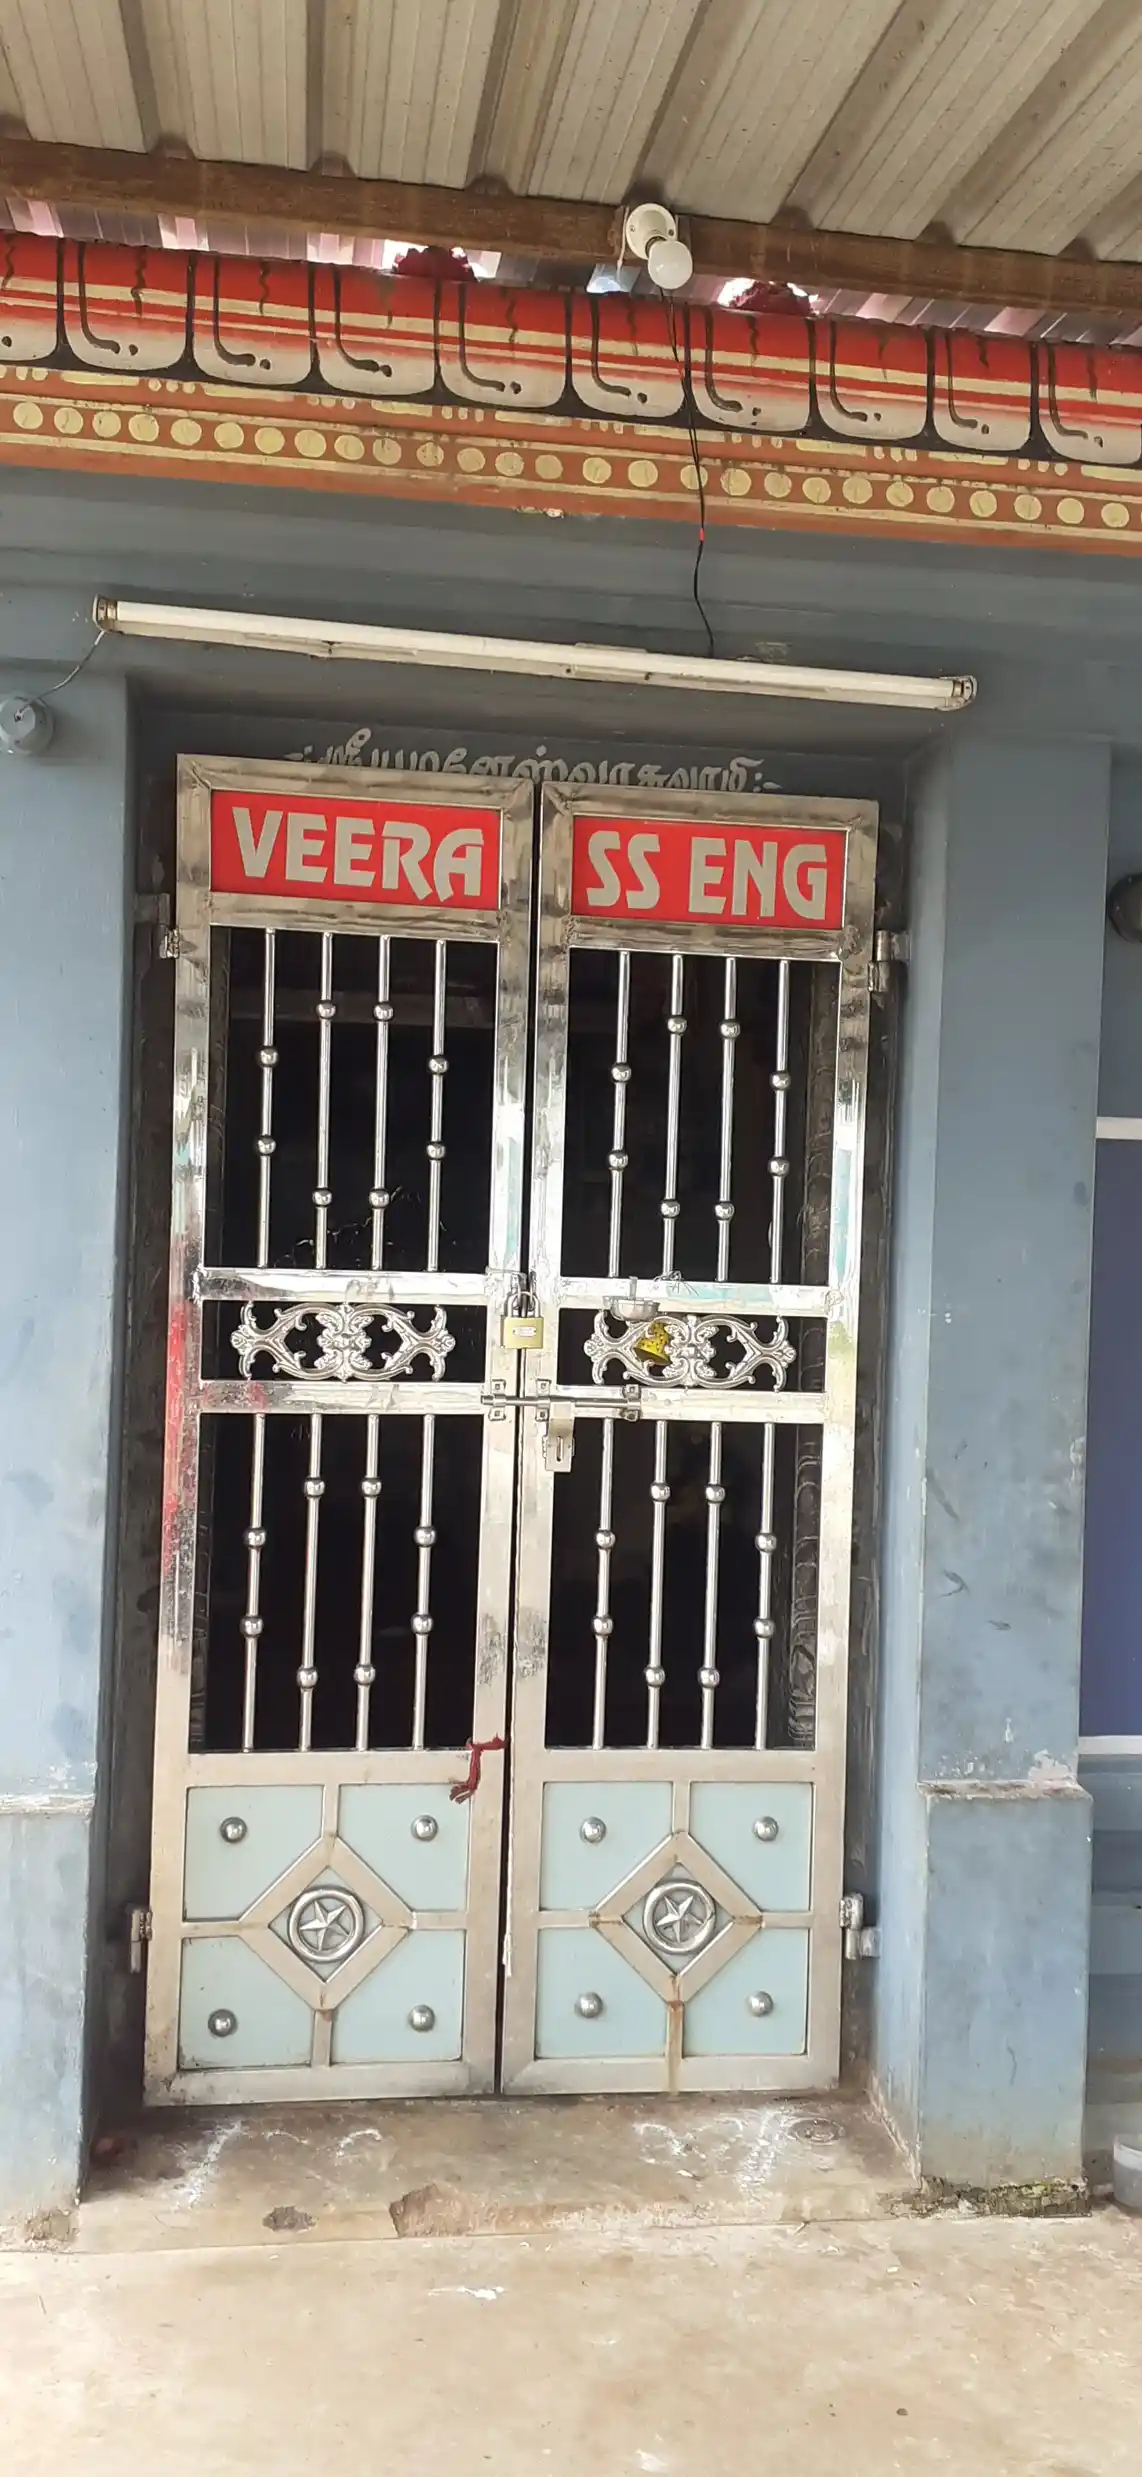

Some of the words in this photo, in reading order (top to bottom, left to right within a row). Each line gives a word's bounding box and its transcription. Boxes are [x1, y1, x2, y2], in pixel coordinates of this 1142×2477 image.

[232, 806, 483, 901] VEERA
[586, 830, 660, 910] SS
[688, 836, 828, 921] ENG
